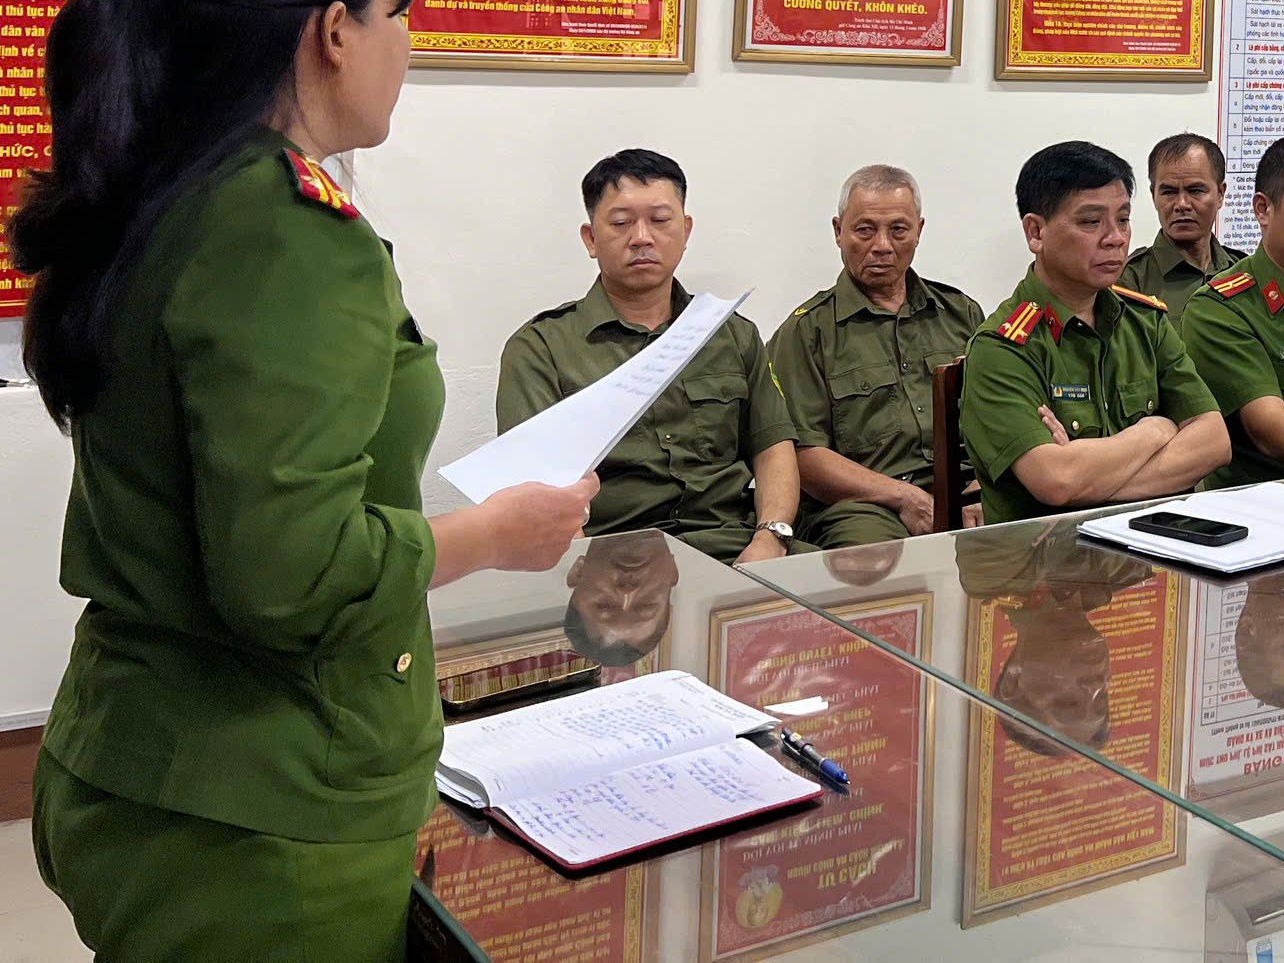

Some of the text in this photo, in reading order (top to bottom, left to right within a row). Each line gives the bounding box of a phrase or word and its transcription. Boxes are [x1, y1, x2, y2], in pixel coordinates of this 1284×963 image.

[825, 0, 862, 12] QUYẾT,
[865, 1, 894, 13] KHÔN
[897, 3, 927, 14] KHÉO.
